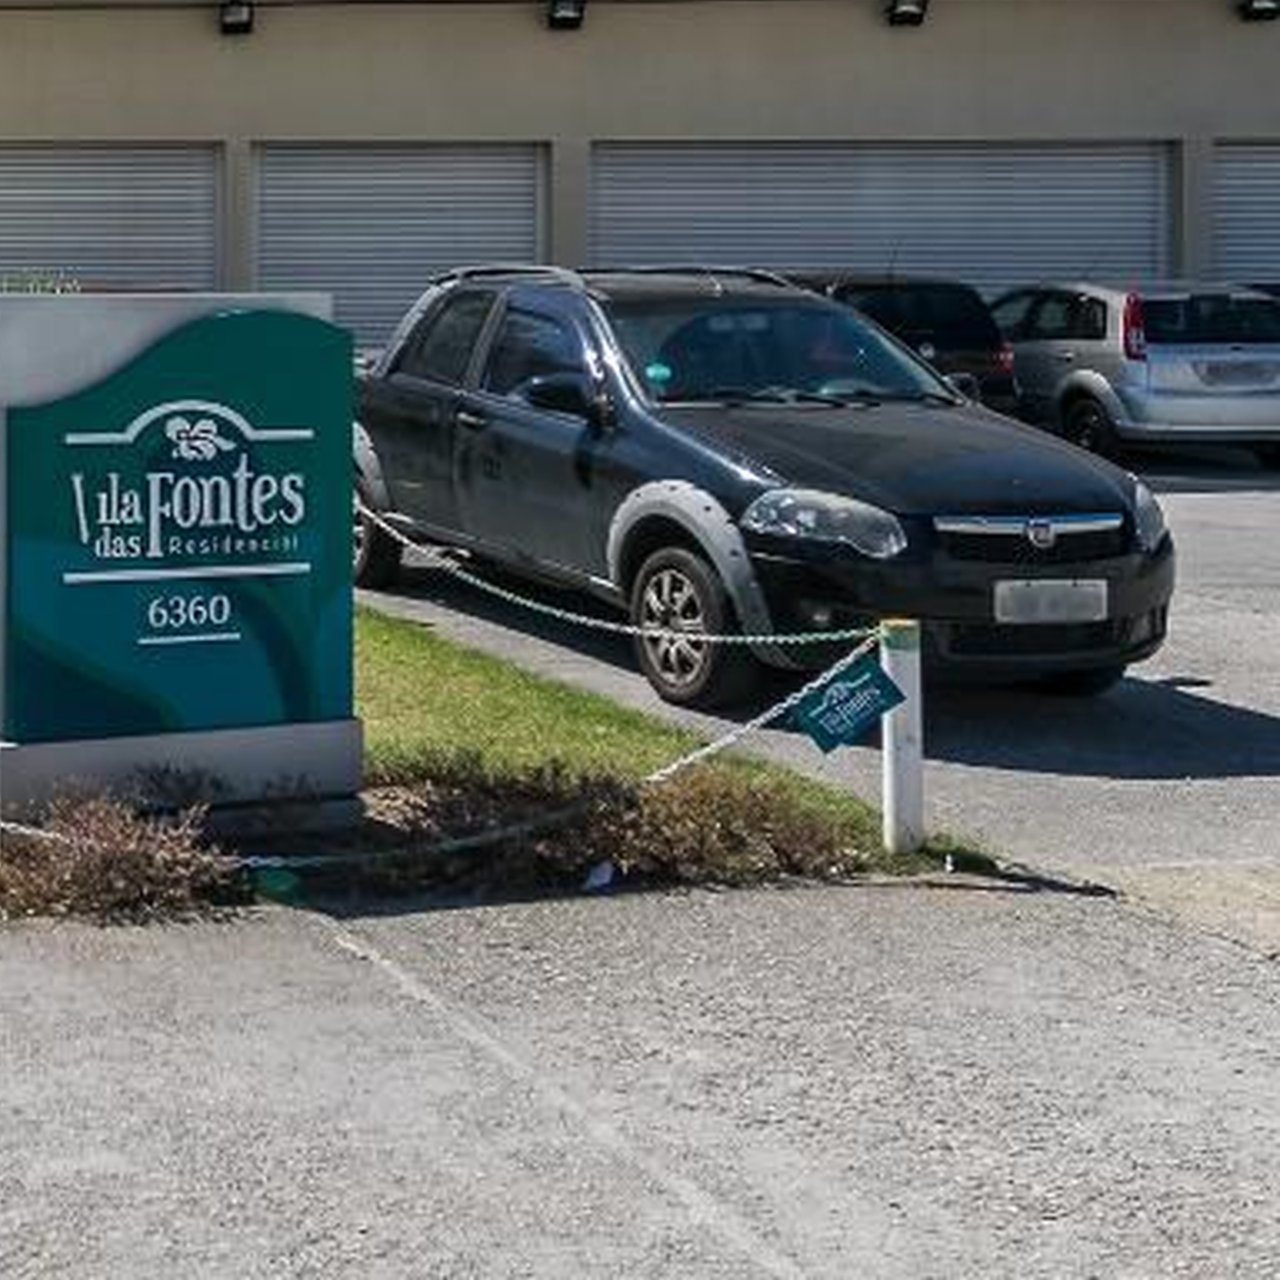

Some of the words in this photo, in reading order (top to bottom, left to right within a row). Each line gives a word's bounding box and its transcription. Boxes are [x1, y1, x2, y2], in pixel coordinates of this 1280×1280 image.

[146, 452, 305, 558] Fontes
[95, 526, 141, 558] das
[148, 593, 231, 628] 6360
